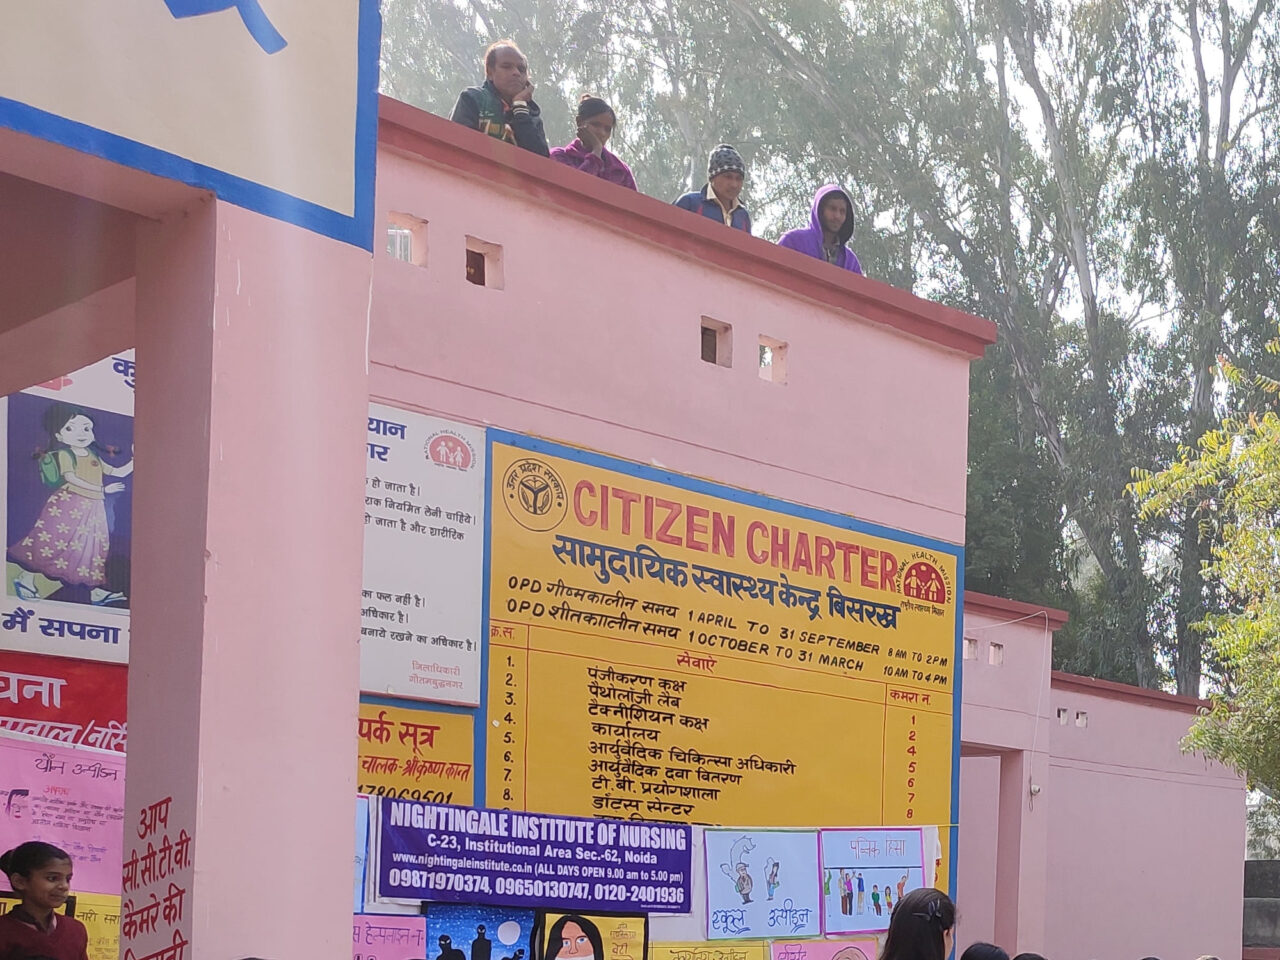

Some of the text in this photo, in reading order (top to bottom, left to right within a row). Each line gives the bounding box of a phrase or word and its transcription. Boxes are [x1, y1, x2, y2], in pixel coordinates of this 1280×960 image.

[385, 497, 422, 514] नियमित
[573, 479, 899, 593] CITIZEN CHARTER
[552, 534, 689, 588] सामुदायिक
[691, 563, 779, 607] स्वास्थ्य
[777, 572, 823, 621] केन्द्र
[895, 551, 952, 605] NATIONAL HEALTH MISSION
[38, 617, 122, 644] सपना
[508, 576, 542, 594] OPD
[641, 599, 680, 619] समय
[688, 610, 694, 623] 1
[697, 612, 738, 630] APRIL
[746, 620, 770, 635] TO
[779, 626, 795, 641] 31
[799, 630, 881, 656] SEPTEMBER
[887, 647, 894, 658] 8
[894, 649, 908, 661] AM
[911, 651, 923, 663] TO
[507, 598, 545, 618] OPD
[642, 620, 682, 640] समय
[696, 632, 770, 656] OCTOBER
[775, 644, 793, 660] TO
[797, 649, 814, 662] 31
[818, 653, 864, 672] MARCH
[883, 665, 894, 677] 10
[894, 667, 909, 680] AM
[932, 673, 948, 686] PM
[504, 673, 517, 687] 2.
[657, 691, 683, 709] लैब
[505, 656, 688, 694] 1. पंजीकरण कक्ष
[504, 692, 710, 733] 3. टैक्नीशियन कक्ष
[889, 688, 920, 705] कमरा
[504, 712, 662, 742] 4. कार्यालय
[908, 730, 917, 742] 2
[910, 715, 917, 726] 1
[503, 732, 515, 744] 5.
[667, 746, 734, 769] चिकित्सा
[735, 754, 798, 776] अधिकारी
[503, 750, 515, 764] 6.
[665, 765, 693, 782] दवा
[696, 766, 743, 786] वितरण
[906, 745, 918, 757] 4
[907, 761, 918, 773] 5
[503, 768, 513, 782] 7.
[640, 779, 721, 802] प्रयोगशाला
[906, 777, 916, 788] 6
[906, 792, 916, 804] 7
[136, 796, 173, 840] आप
[502, 788, 696, 817] 8. सेन्टर
[906, 808, 914, 819] 8
[390, 801, 509, 837] NIGHTINGALE
[511, 813, 595, 845] INSTITUTE
[597, 823, 617, 846] OF
[618, 824, 687, 851] NURSING
[427, 833, 462, 853] C-23,
[465, 837, 541, 858] Institutional
[543, 844, 574, 860] Area
[625, 851, 658, 865] Noida
[392, 852, 684, 885] www.nightingaleinstitute.co.in (ALL DAYS OPEN 9.00 am to 5.00 pm)
[388, 868, 493, 895] 09871970374,
[495, 876, 592, 900] 09650130747,
[594, 883, 685, 904] 0120-2401936
[122, 882, 187, 941] कैमरे की
